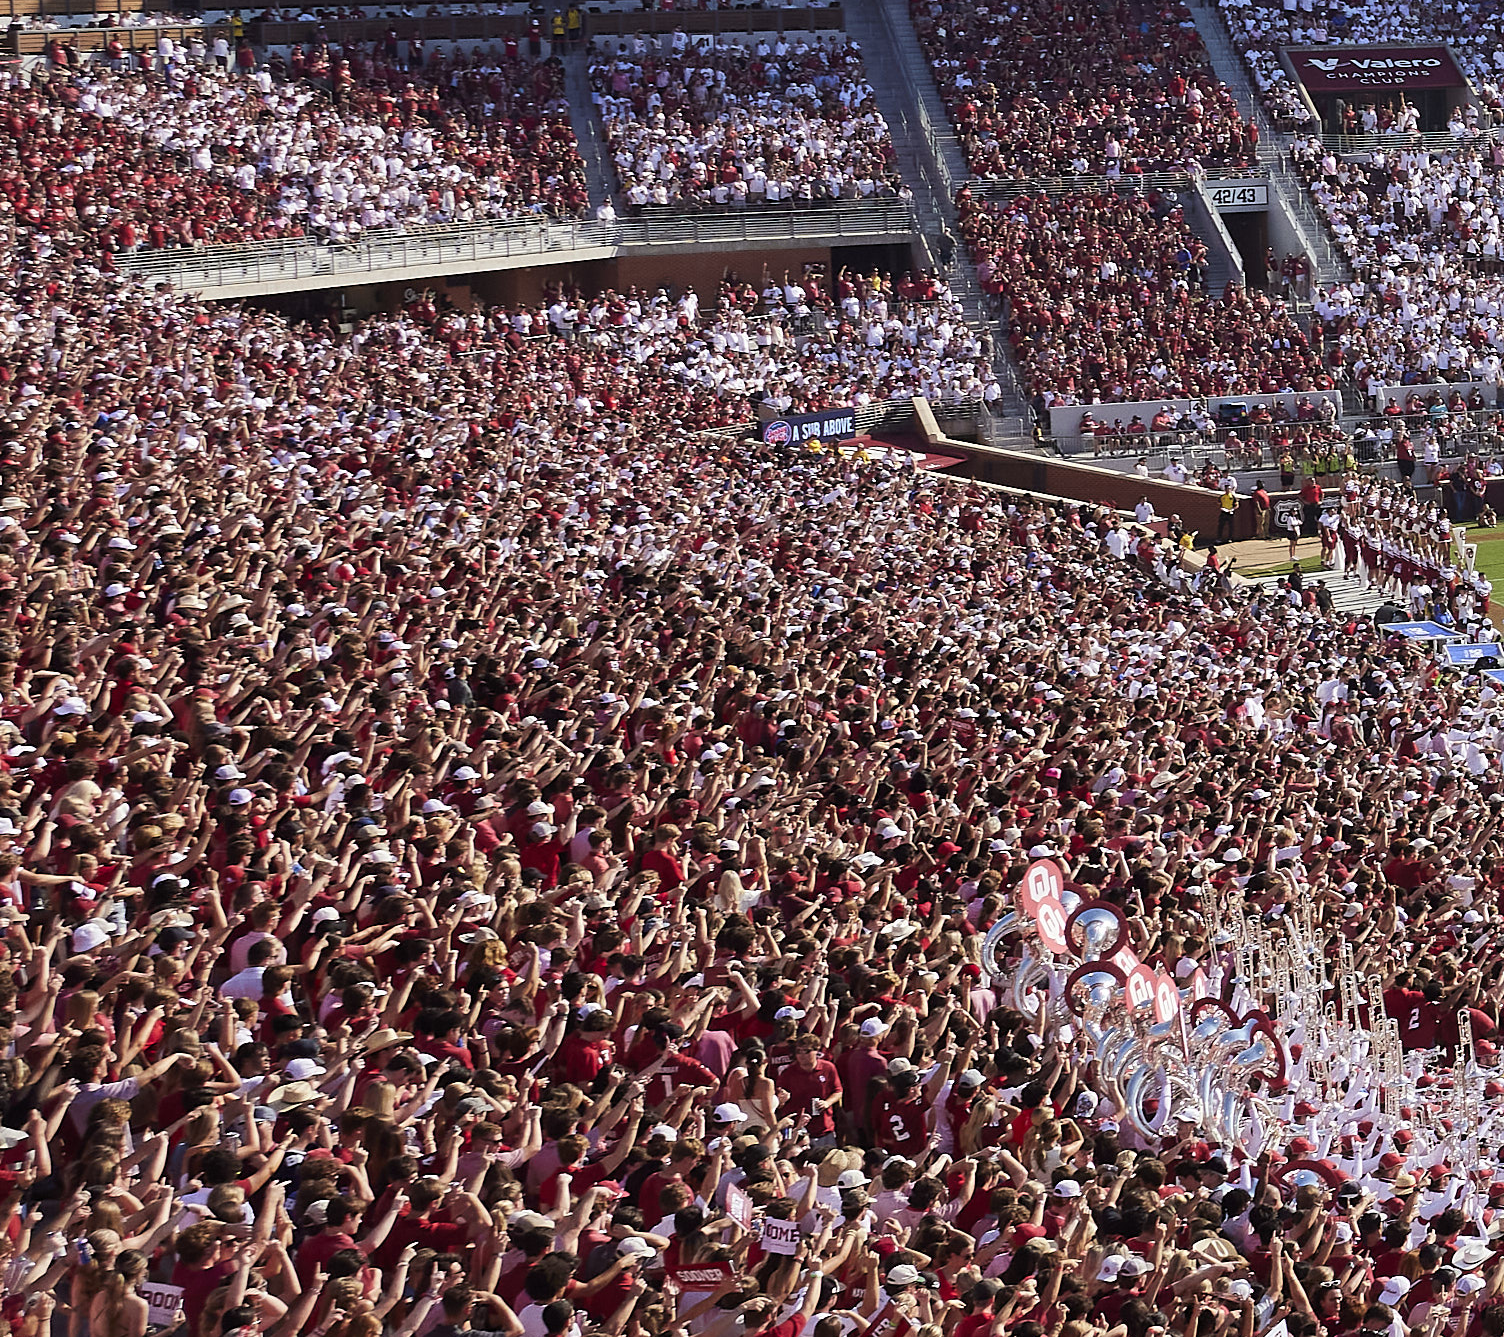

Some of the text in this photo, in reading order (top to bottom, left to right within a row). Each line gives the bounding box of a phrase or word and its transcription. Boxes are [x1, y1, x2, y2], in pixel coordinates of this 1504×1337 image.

[1351, 56, 1441, 70] Valero
[1326, 70, 1430, 81] CHAMPIONS
[1360, 77, 1405, 85] CLUB
[1212, 187, 1256, 202] 42/43
[793, 425, 801, 441] A
[802, 422, 821, 439] SUB
[676, 1269, 722, 1281] SOONER
